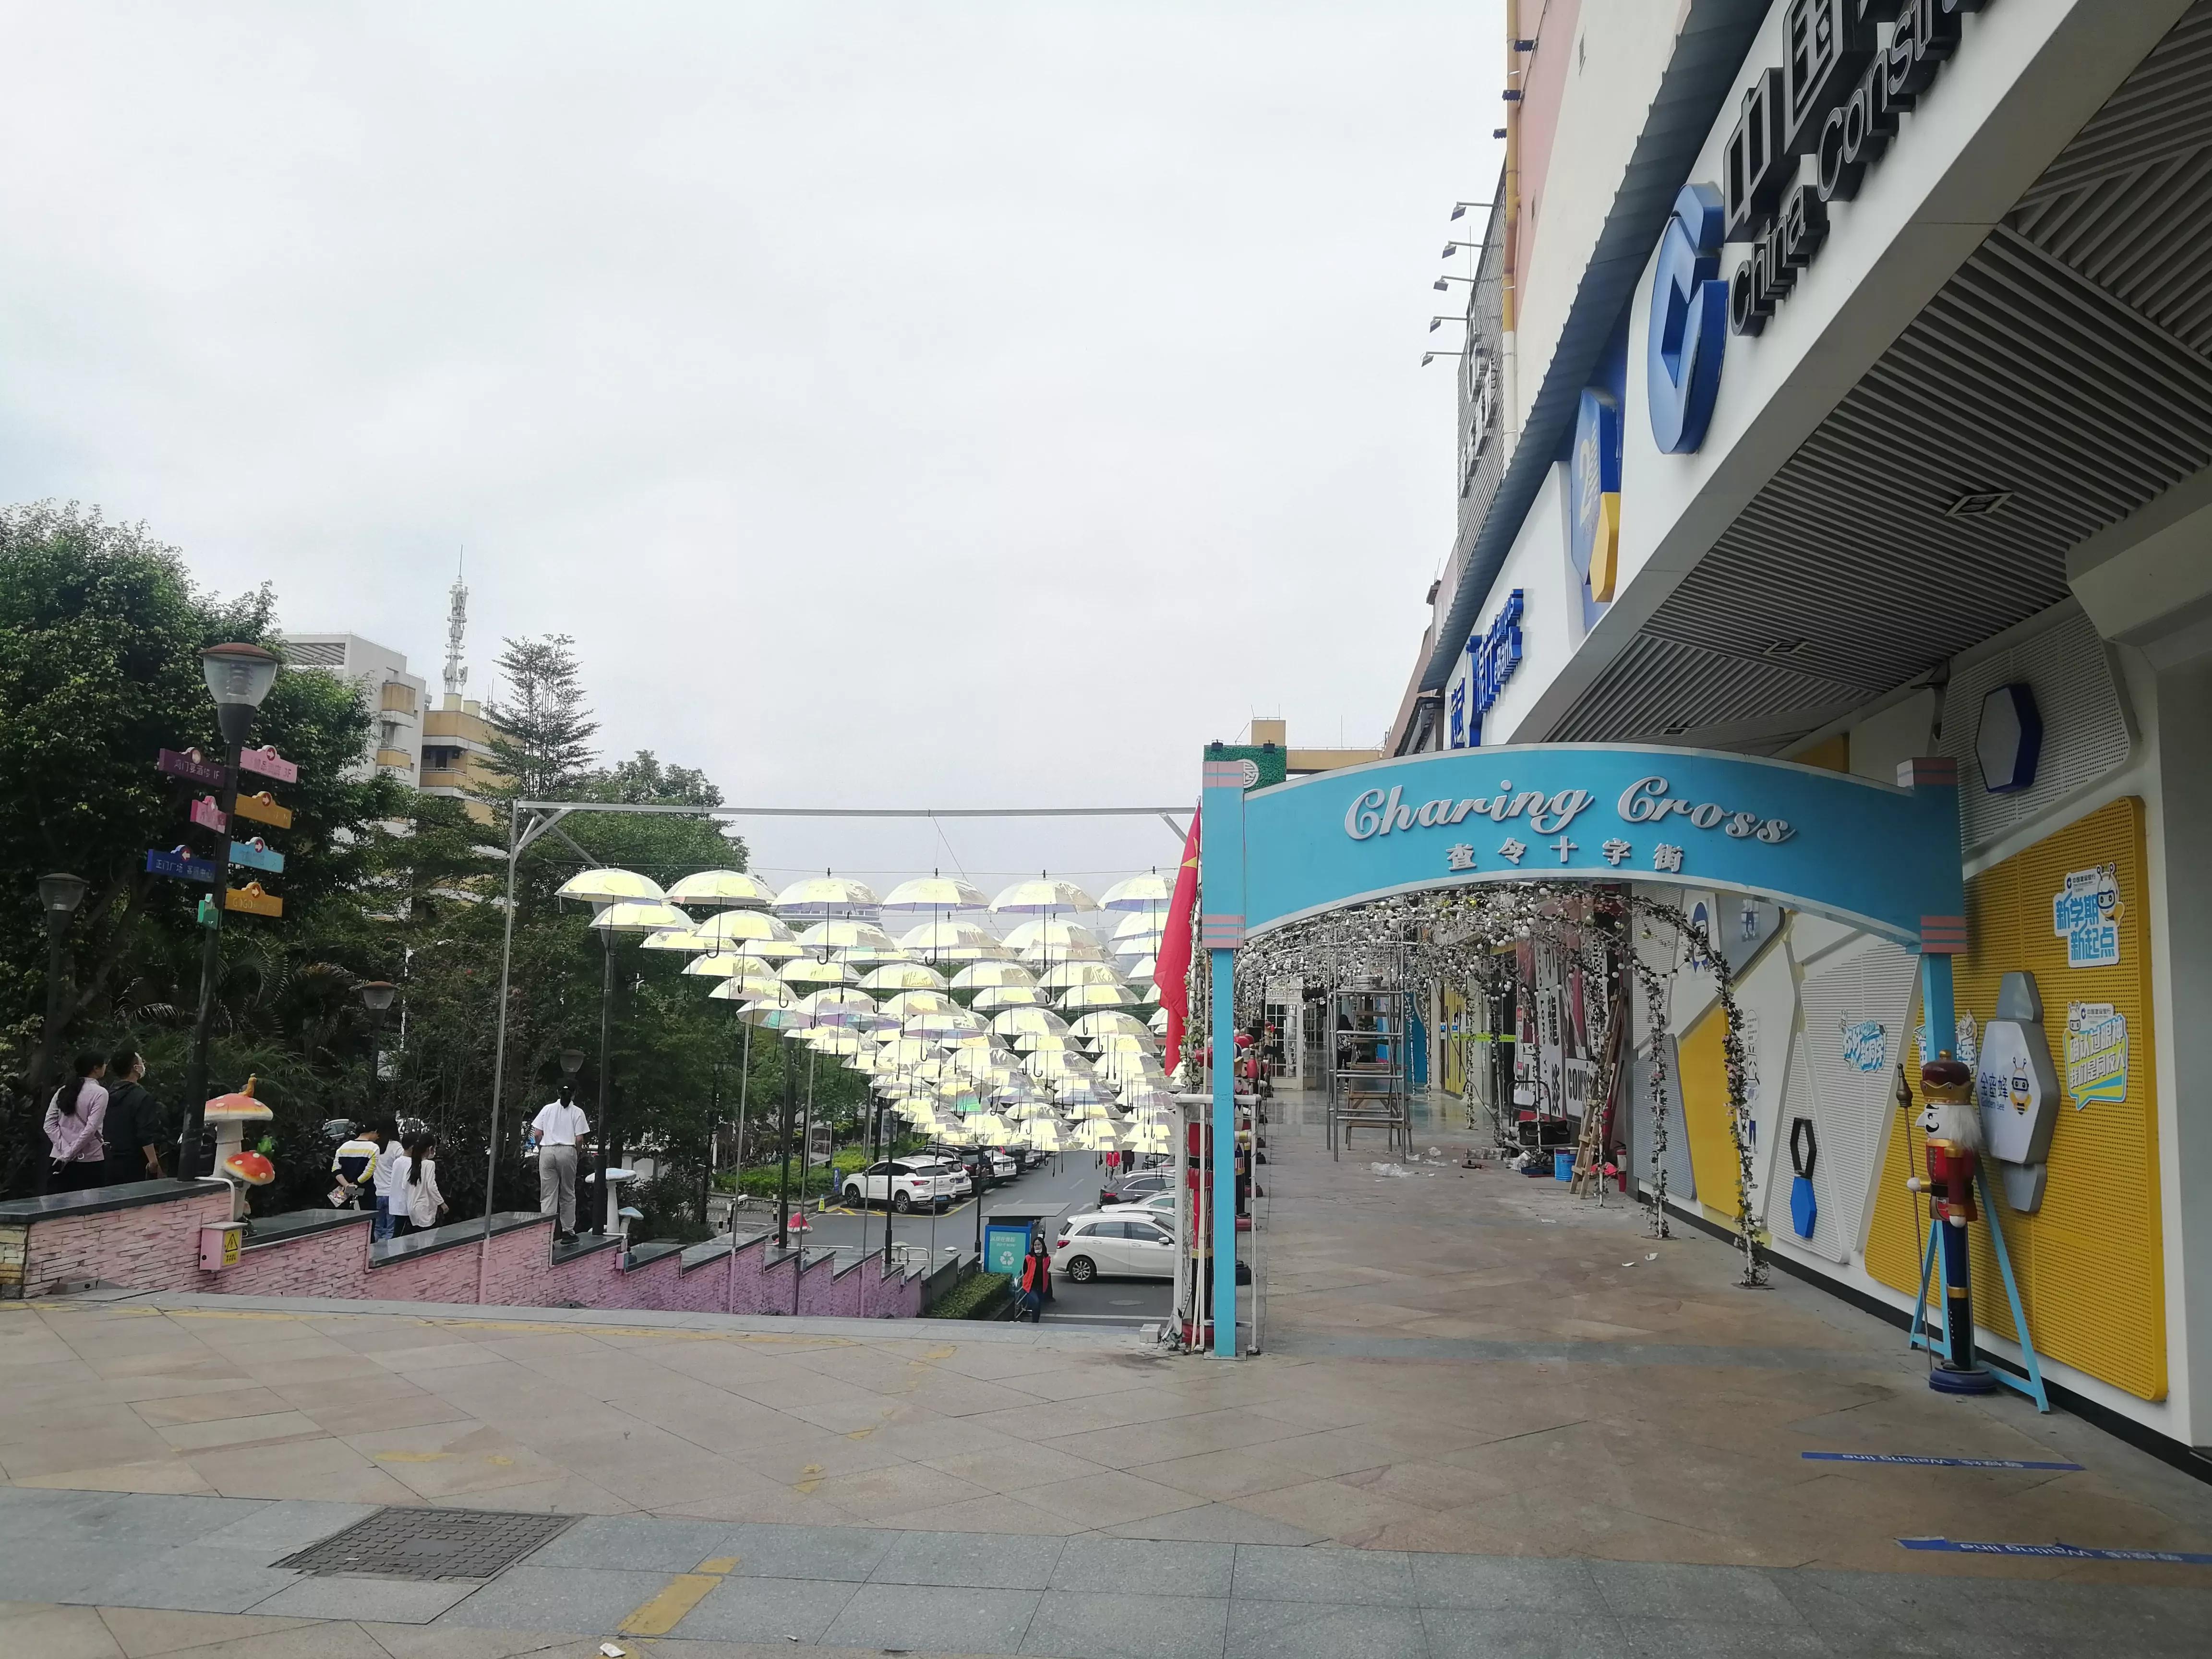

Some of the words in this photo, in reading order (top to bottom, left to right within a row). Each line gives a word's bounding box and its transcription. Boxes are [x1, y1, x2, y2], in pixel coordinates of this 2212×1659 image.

[1731, 184, 1806, 337] China
[1494, 626, 1513, 685] eBank
[1345, 779, 1595, 841] Charing
[1617, 776, 1797, 843] Cross
[1445, 835, 1684, 873] 查令十字街
[2056, 890, 2099, 930] 新学期
[2070, 922, 2116, 961] 新起点
[2069, 1017, 2124, 1064] 确认过眼神
[1981, 1072, 2008, 1100] 金蜜蜂
[1981, 1097, 1996, 1109] Golden
[1996, 1101, 2005, 1111] Bee
[1879, 1455, 1952, 1466] Waiting
[1960, 1542, 2001, 1552] line
[2005, 1545, 2093, 1558] Waiting
